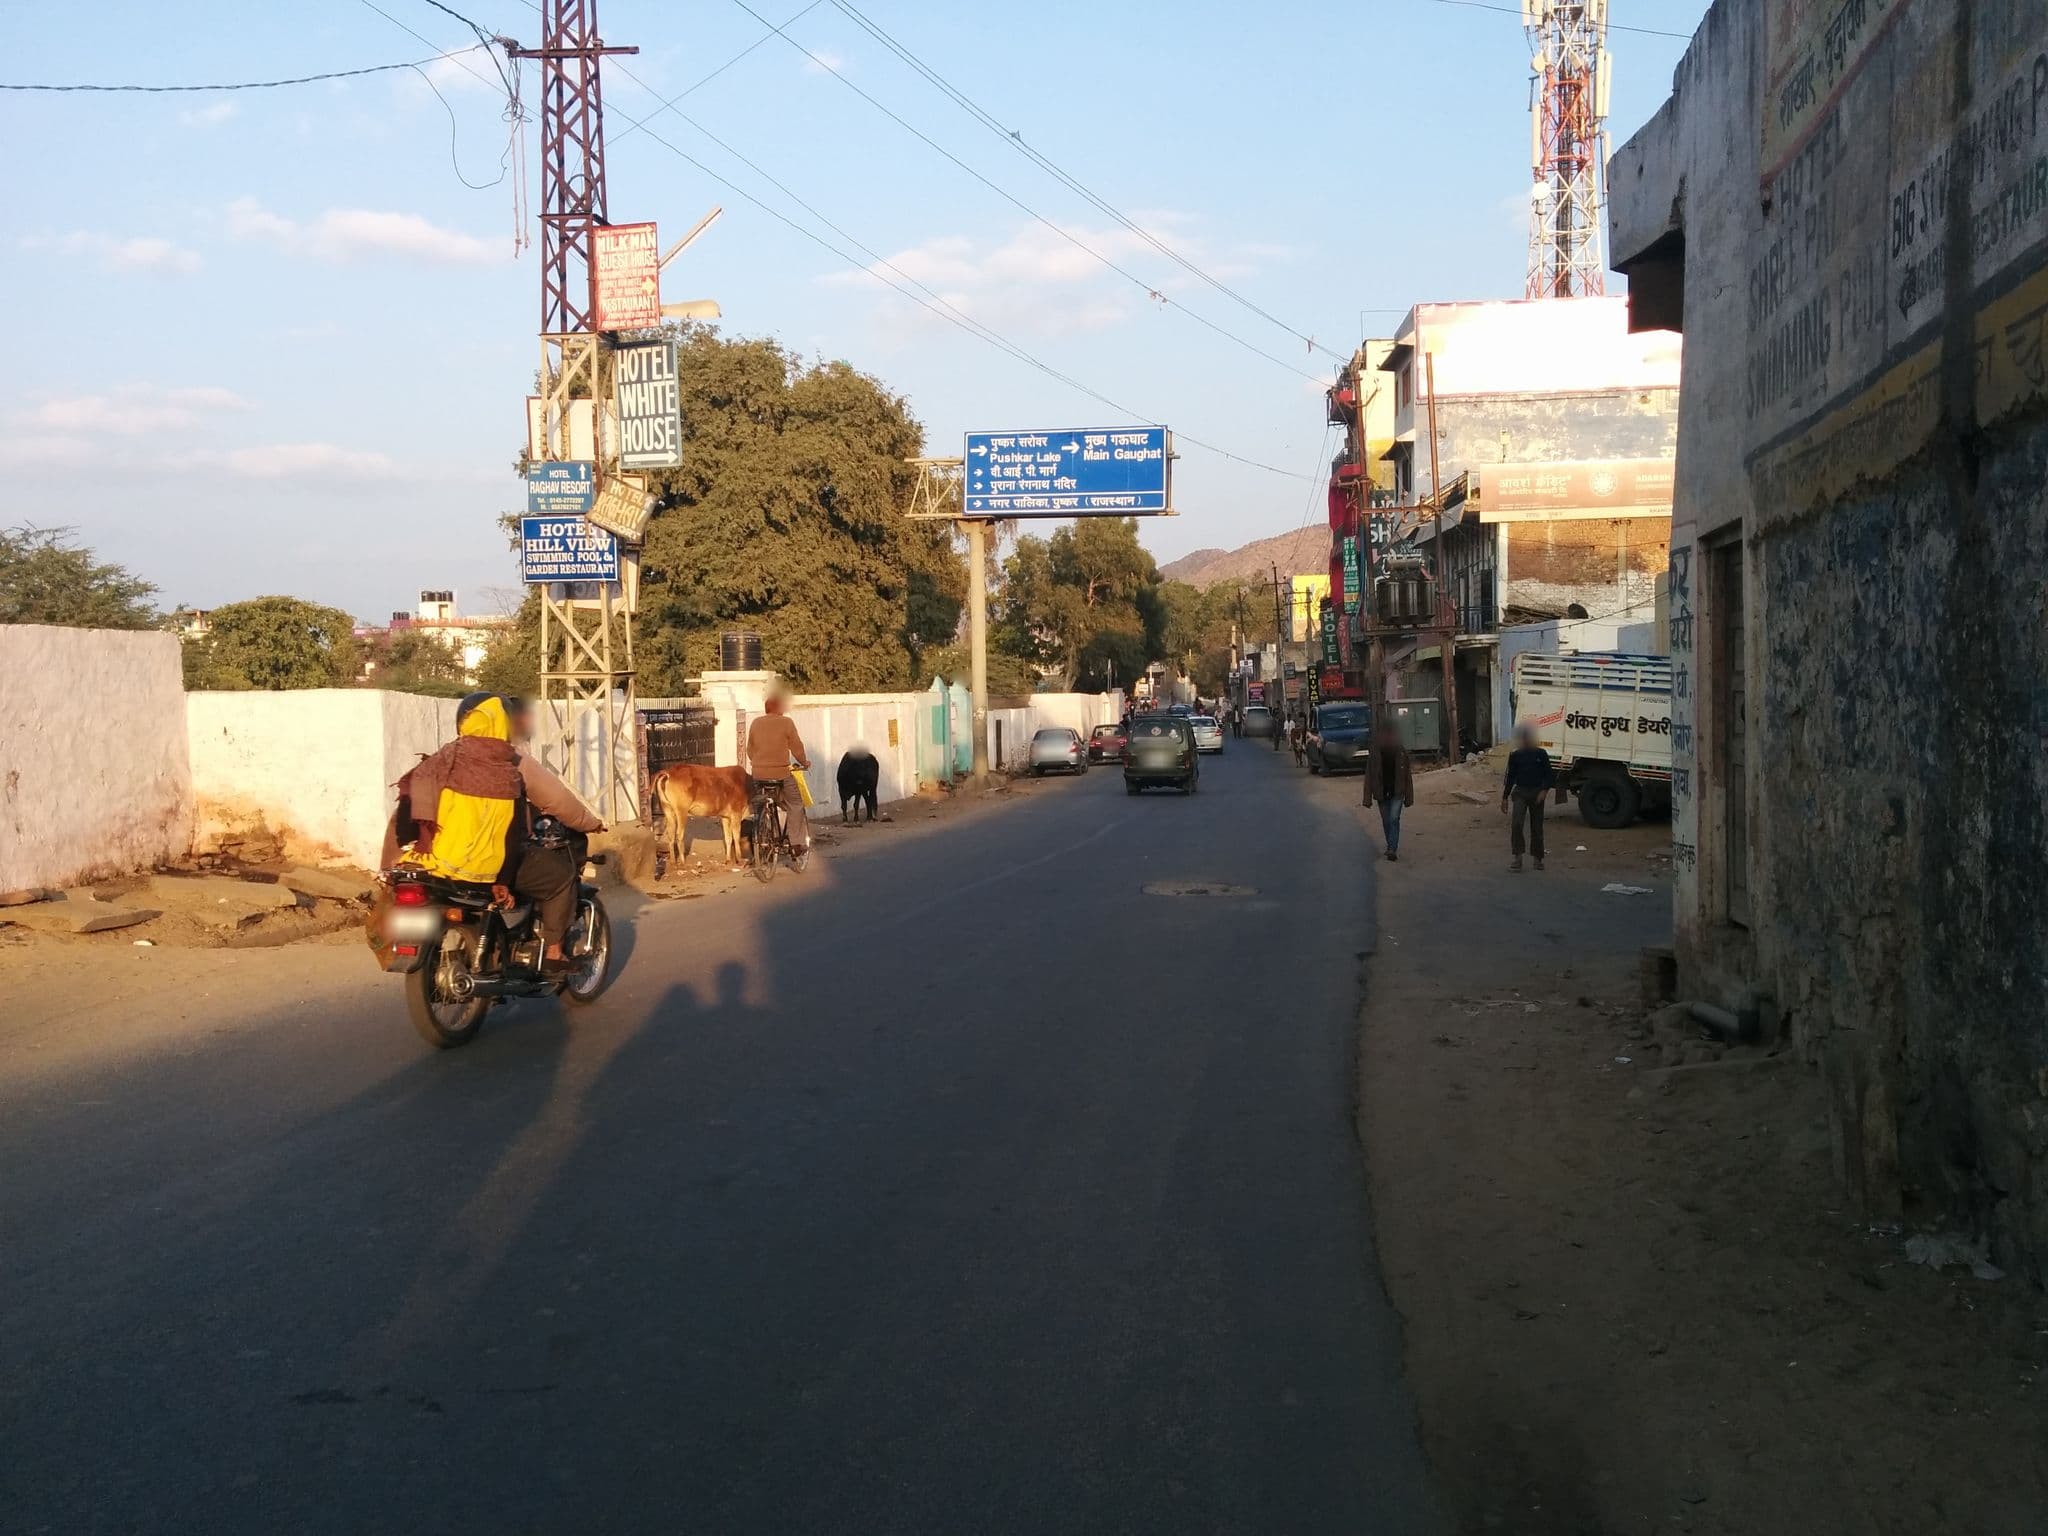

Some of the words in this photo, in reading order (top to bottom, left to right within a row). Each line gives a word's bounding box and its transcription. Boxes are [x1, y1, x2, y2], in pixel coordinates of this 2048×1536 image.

[1893, 181, 1917, 259] BIG
[598, 236, 627, 251] MILK
[631, 233, 656, 248] MAN
[599, 252, 629, 269] GUEST
[632, 250, 656, 266] HOUSE
[618, 346, 674, 383] HOTEL
[620, 380, 677, 419] WHITE
[621, 416, 676, 453] HOUSE
[990, 437, 1015, 452] पुष्कर
[1019, 434, 1048, 447] सरोवर
[1084, 435, 1107, 450] मुख्य
[1110, 433, 1149, 446] गऊघाट
[990, 452, 1033, 463] Pushkar
[1037, 452, 1061, 462] Lake
[1084, 449, 1110, 460] Main
[1114, 448, 1162, 462] Gaughat
[549, 470, 570, 478] HOTEL
[1039, 463, 1057, 477] मार्ग
[530, 480, 560, 494] RAGHAV
[560, 480, 590, 494] RESORT
[610, 480, 644, 506] HOTEL
[990, 480, 1016, 494] पुराना
[1019, 479, 1050, 491] रंगनाथ
[1053, 478, 1077, 490] मंदिर
[989, 498, 1010, 508] नगर
[1052, 497, 1078, 508] पुष्कर
[540, 523, 596, 536] HOTEL
[591, 512, 642, 540] RESORT
[526, 540, 564, 552] HILL
[565, 538, 612, 551] VIEW
[526, 552, 574, 562] SWIMMING
[578, 552, 602, 562] POOL
[604, 552, 613, 561] &
[526, 564, 559, 575] GARDEN
[560, 564, 614, 574] RESTAURANT
[1324, 612, 1338, 664] HOTEL
[1566, 710, 1597, 731] शंकर
[1601, 717, 1631, 737] दुग्ध
